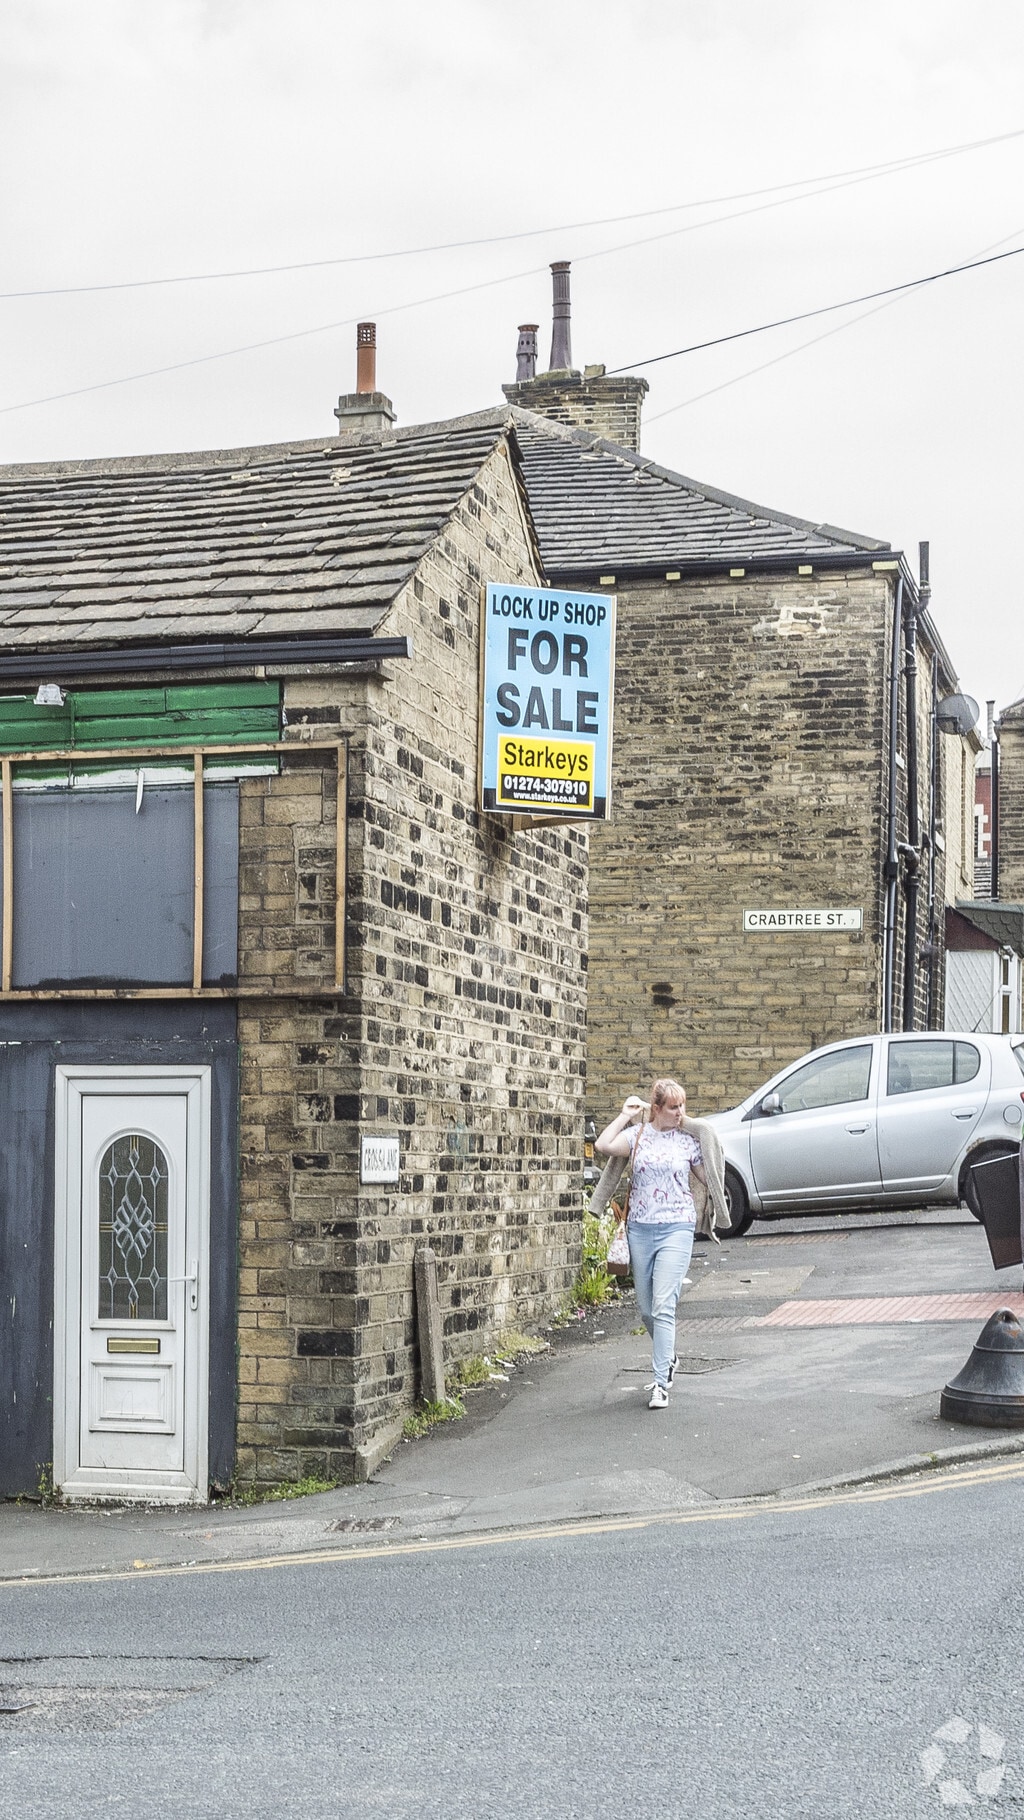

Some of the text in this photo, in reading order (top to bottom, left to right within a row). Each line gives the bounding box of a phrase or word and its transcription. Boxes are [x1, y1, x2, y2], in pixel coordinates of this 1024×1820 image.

[492, 594, 606, 626] LOCK UP SHOP
[507, 627, 588, 677] FOR
[496, 682, 599, 734] SALE
[504, 742, 589, 776] Starkeys
[504, 776, 587, 796] 01274-307910
[513, 791, 577, 804] www.starkeys.co.uk
[748, 913, 822, 926] CRABTREE
[826, 913, 847, 926] ST.
